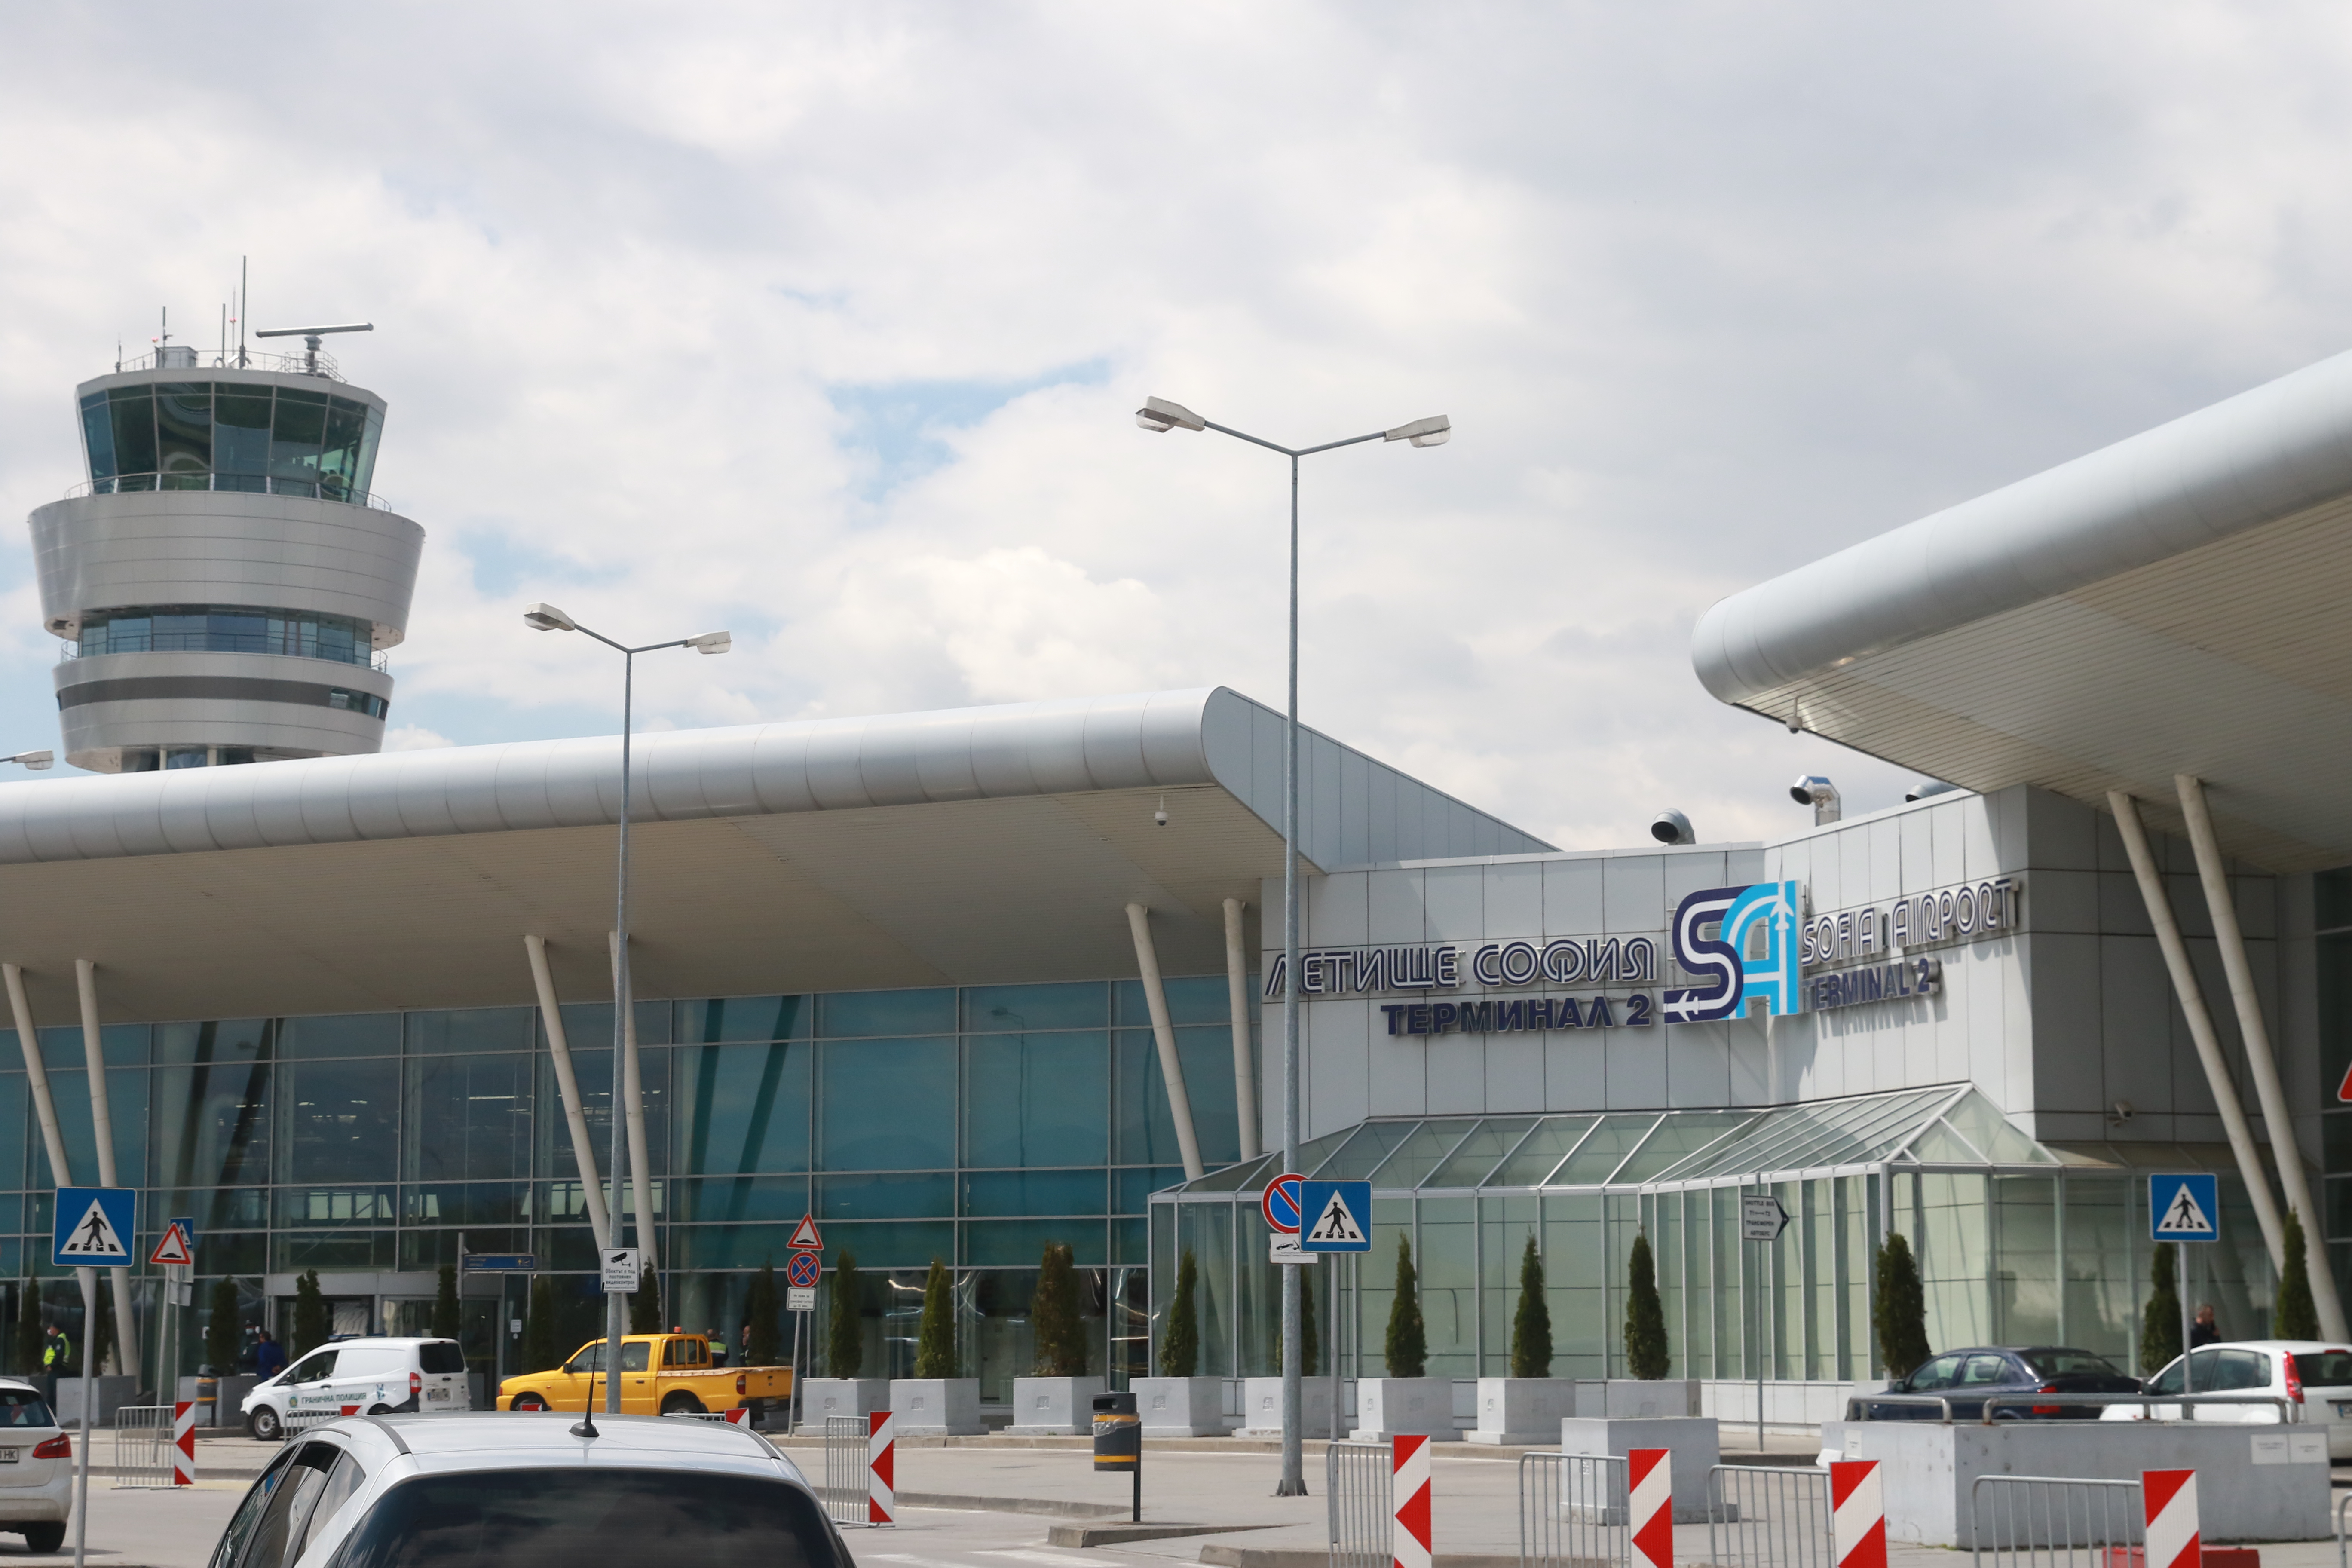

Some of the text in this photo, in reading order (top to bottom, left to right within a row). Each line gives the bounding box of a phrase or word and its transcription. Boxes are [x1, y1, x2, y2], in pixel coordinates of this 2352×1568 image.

[1801, 878, 2014, 965] SOFIA AIRPORT
[1473, 937, 1656, 986] СОФИЯ
[1801, 958, 1931, 1011] TERMINAL 2
[1380, 994, 1650, 1035] ТЕРМИНАЛ 2
[302, 1392, 367, 1404] ГРАНИЧНА ПОЛИЦИЯ
